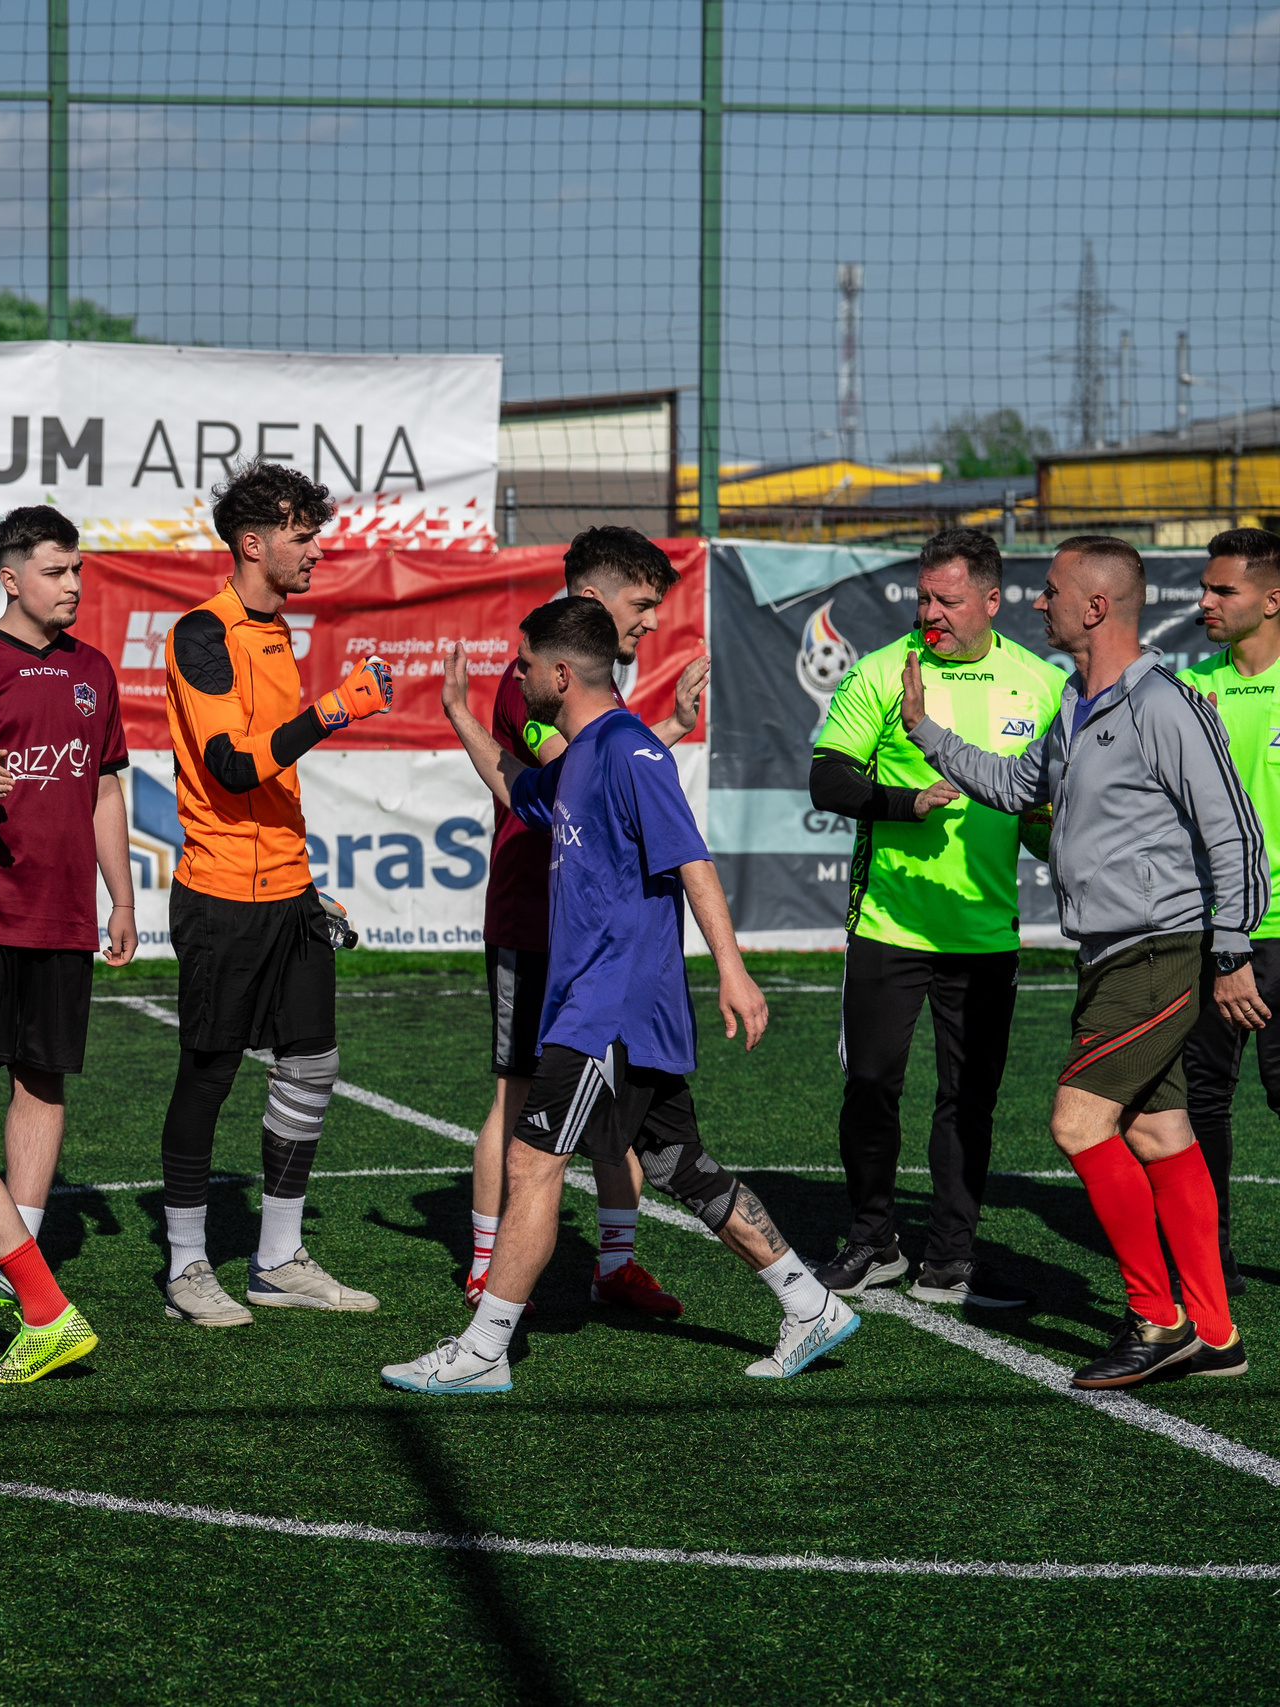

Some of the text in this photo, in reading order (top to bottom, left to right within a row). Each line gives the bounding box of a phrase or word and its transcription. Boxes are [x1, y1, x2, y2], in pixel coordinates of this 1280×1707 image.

[132, 419, 424, 492] ARENA
[346, 637, 377, 653] FPS
[19, 666, 70, 678] GIVOVA
[408, 660, 427, 676] de
[941, 672, 995, 682] GIVOVA
[1225, 685, 1275, 695] GIVOVA
[367, 927, 414, 944] Hale
[418, 927, 438, 944] la
